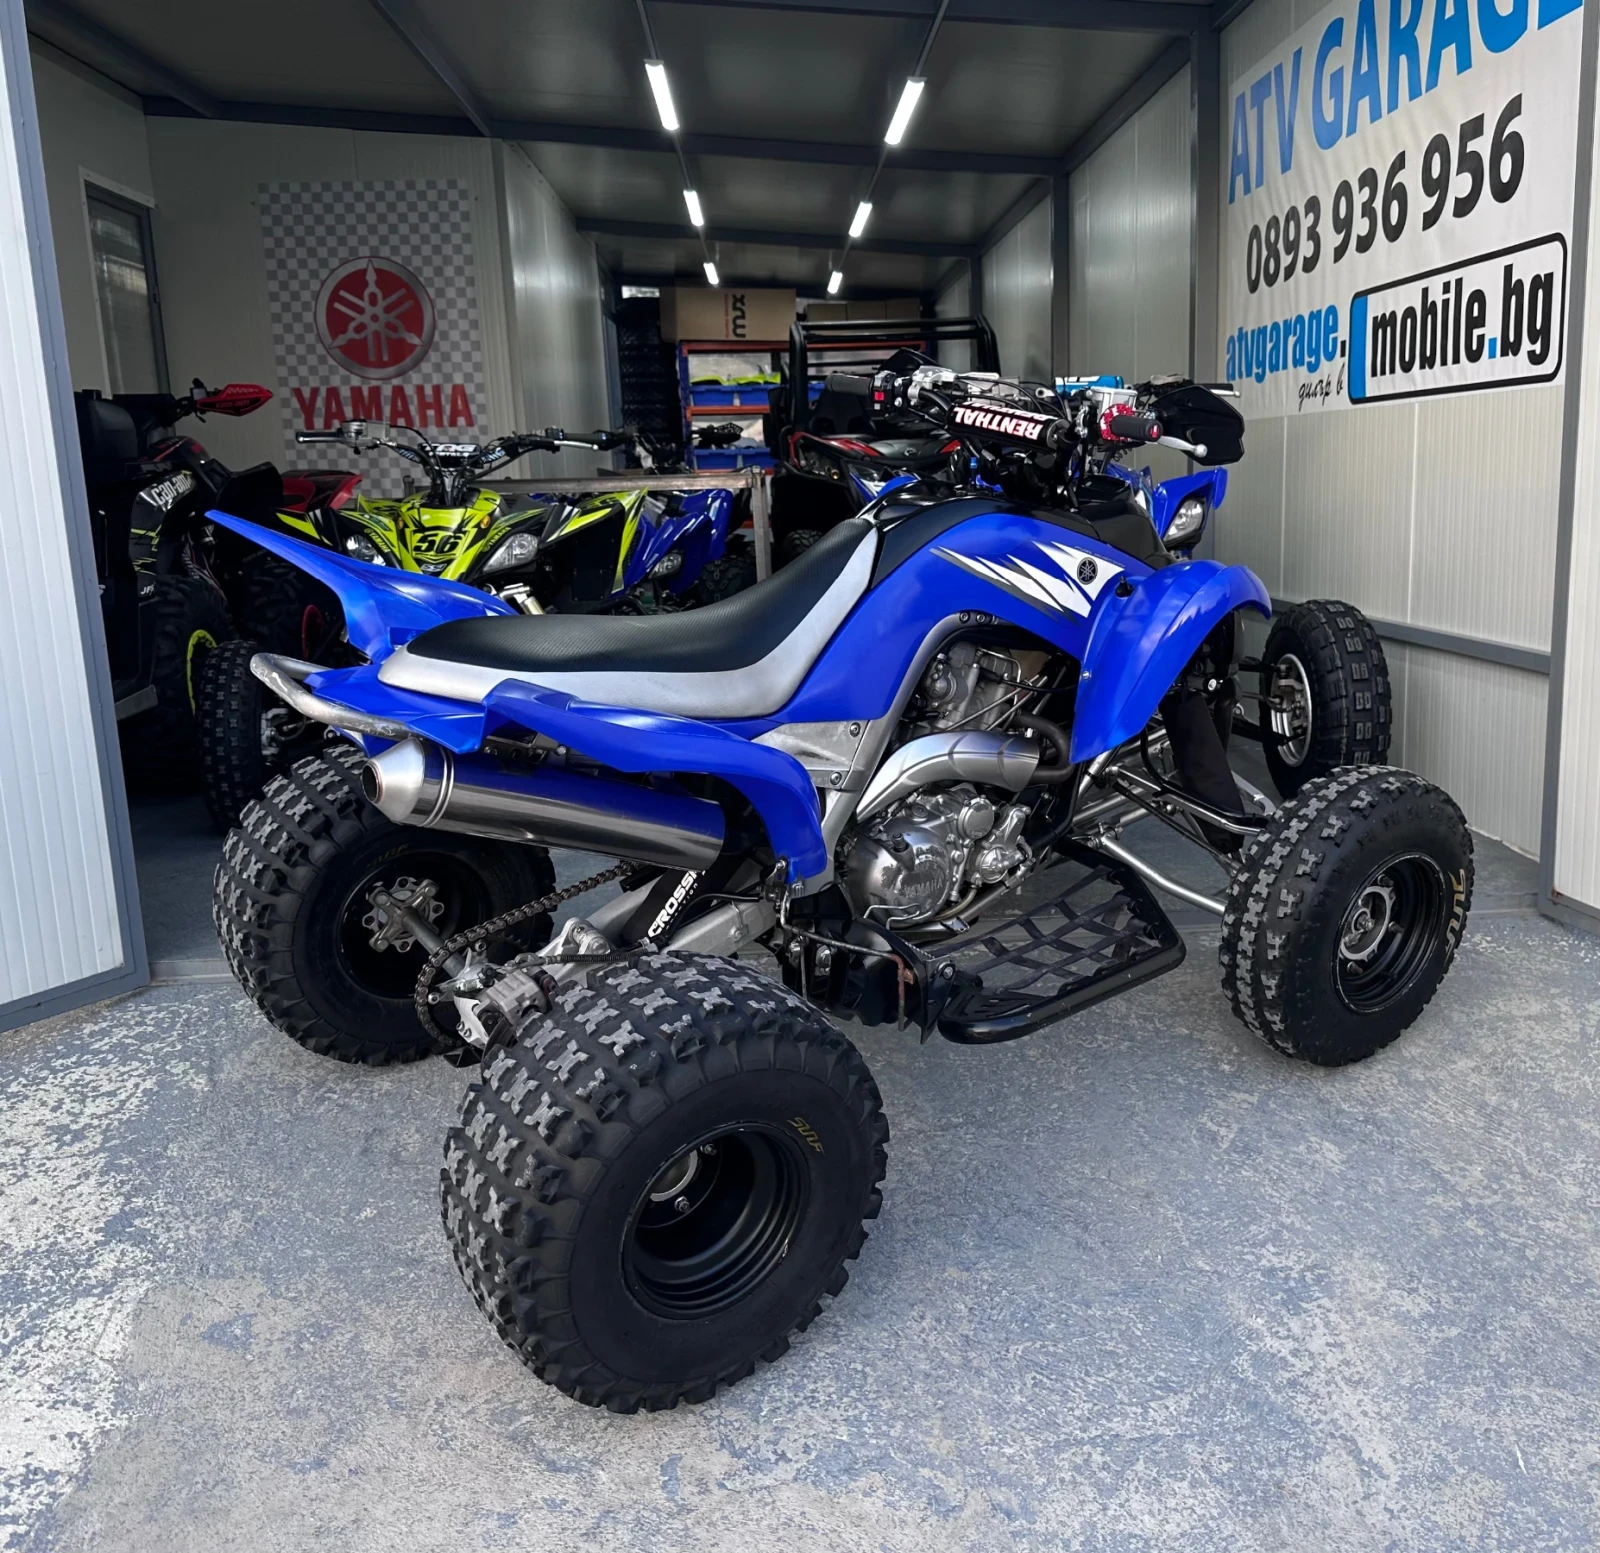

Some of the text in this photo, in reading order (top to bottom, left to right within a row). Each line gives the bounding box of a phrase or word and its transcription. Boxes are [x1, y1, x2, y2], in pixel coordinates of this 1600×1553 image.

[1229, 0, 1584, 205] ATV GARA
[1246, 92, 1525, 294] 0893 936 956
[1371, 263, 1555, 378] mobile.bg
[292, 384, 476, 430] YAMAHA
[953, 406, 1044, 440] RENTHAL
[151, 474, 191, 505] can-am
[413, 533, 463, 554] 56
[903, 877, 944, 899] YAMAHA
